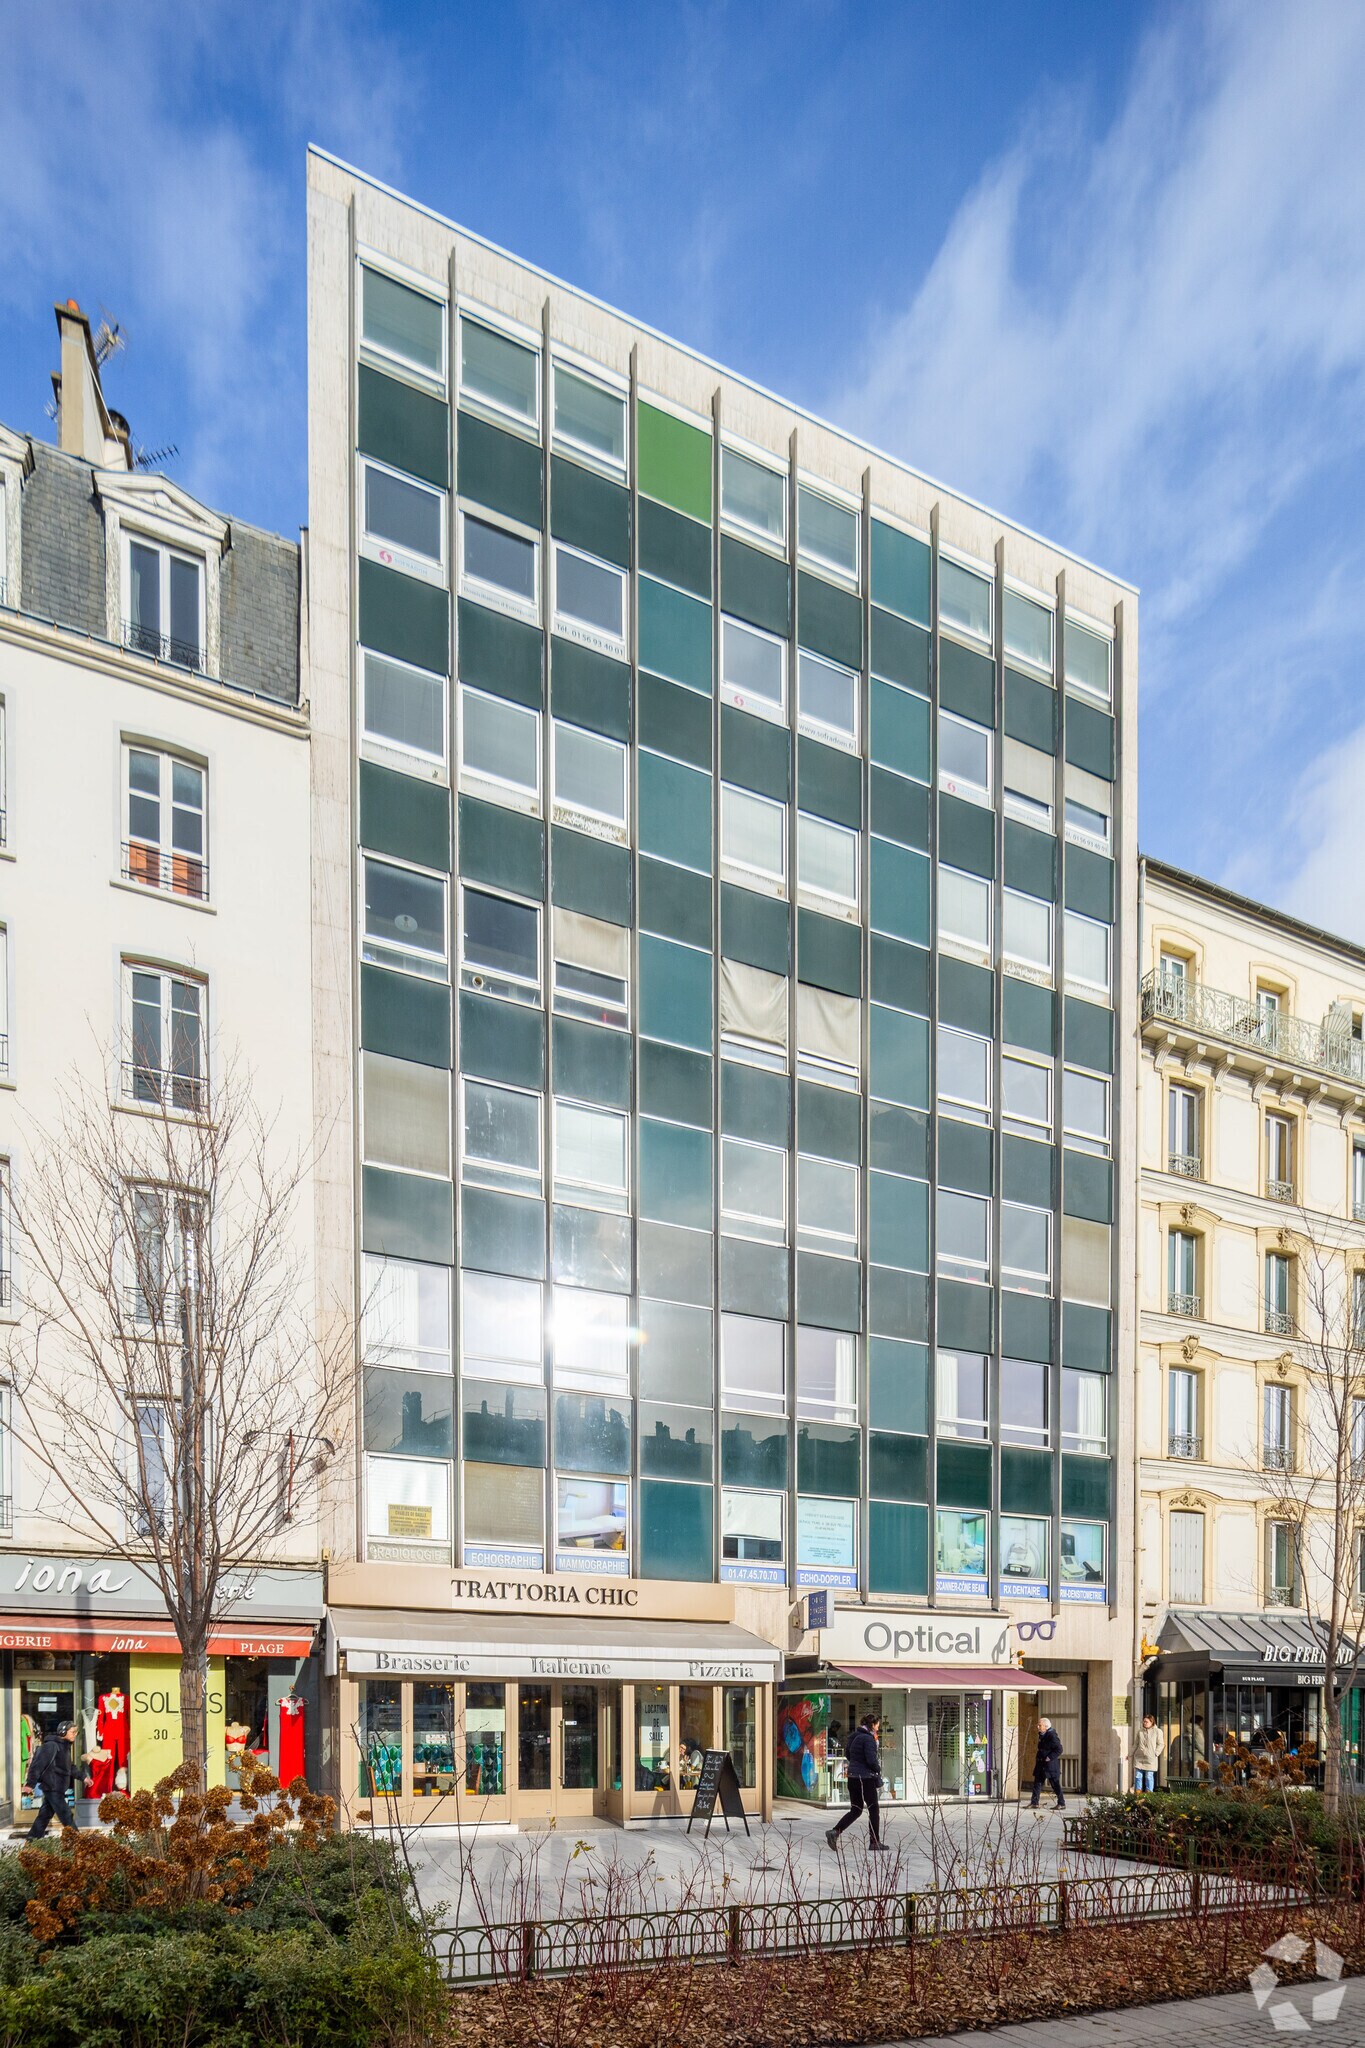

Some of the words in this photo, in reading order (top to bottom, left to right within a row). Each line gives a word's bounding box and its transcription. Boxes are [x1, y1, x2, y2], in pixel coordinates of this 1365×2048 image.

[571, 630, 580, 639] 01
[582, 634, 591, 643] 56
[593, 638, 602, 647] 93
[614, 648, 623, 656] 01
[471, 1552, 538, 1567] ECHOGRAPHIE
[559, 1557, 625, 1571] MAMMOGRAPHIE
[15, 1558, 132, 1594] iona
[728, 1568, 778, 1581] 01.47.45.70.70
[800, 1573, 851, 1585] ECHO-DOPPLER
[450, 1579, 581, 1604] TRATTORIA
[585, 1587, 638, 1606] CHIC
[972, 1583, 985, 1593] BEAM
[1003, 1584, 1012, 1594] RX
[1013, 1585, 1040, 1596] DENTAIRE
[110, 1636, 149, 1654] iona
[240, 1642, 285, 1655] PLAGE
[864, 1621, 980, 1659] Optical
[1264, 1645, 1291, 1662] BIG
[1293, 1646, 1354, 1665] FERNND
[375, 1652, 470, 1672] Brasserie
[530, 1656, 612, 1675] Italienne
[688, 1661, 754, 1679] Pizzeria
[1297, 1674, 1311, 1685] BIG
[134, 1691, 223, 1714] SOLS
[644, 1703, 668, 1714] LOCATION
[652, 1717, 660, 1728] DE
[648, 1730, 664, 1742] SALLE
